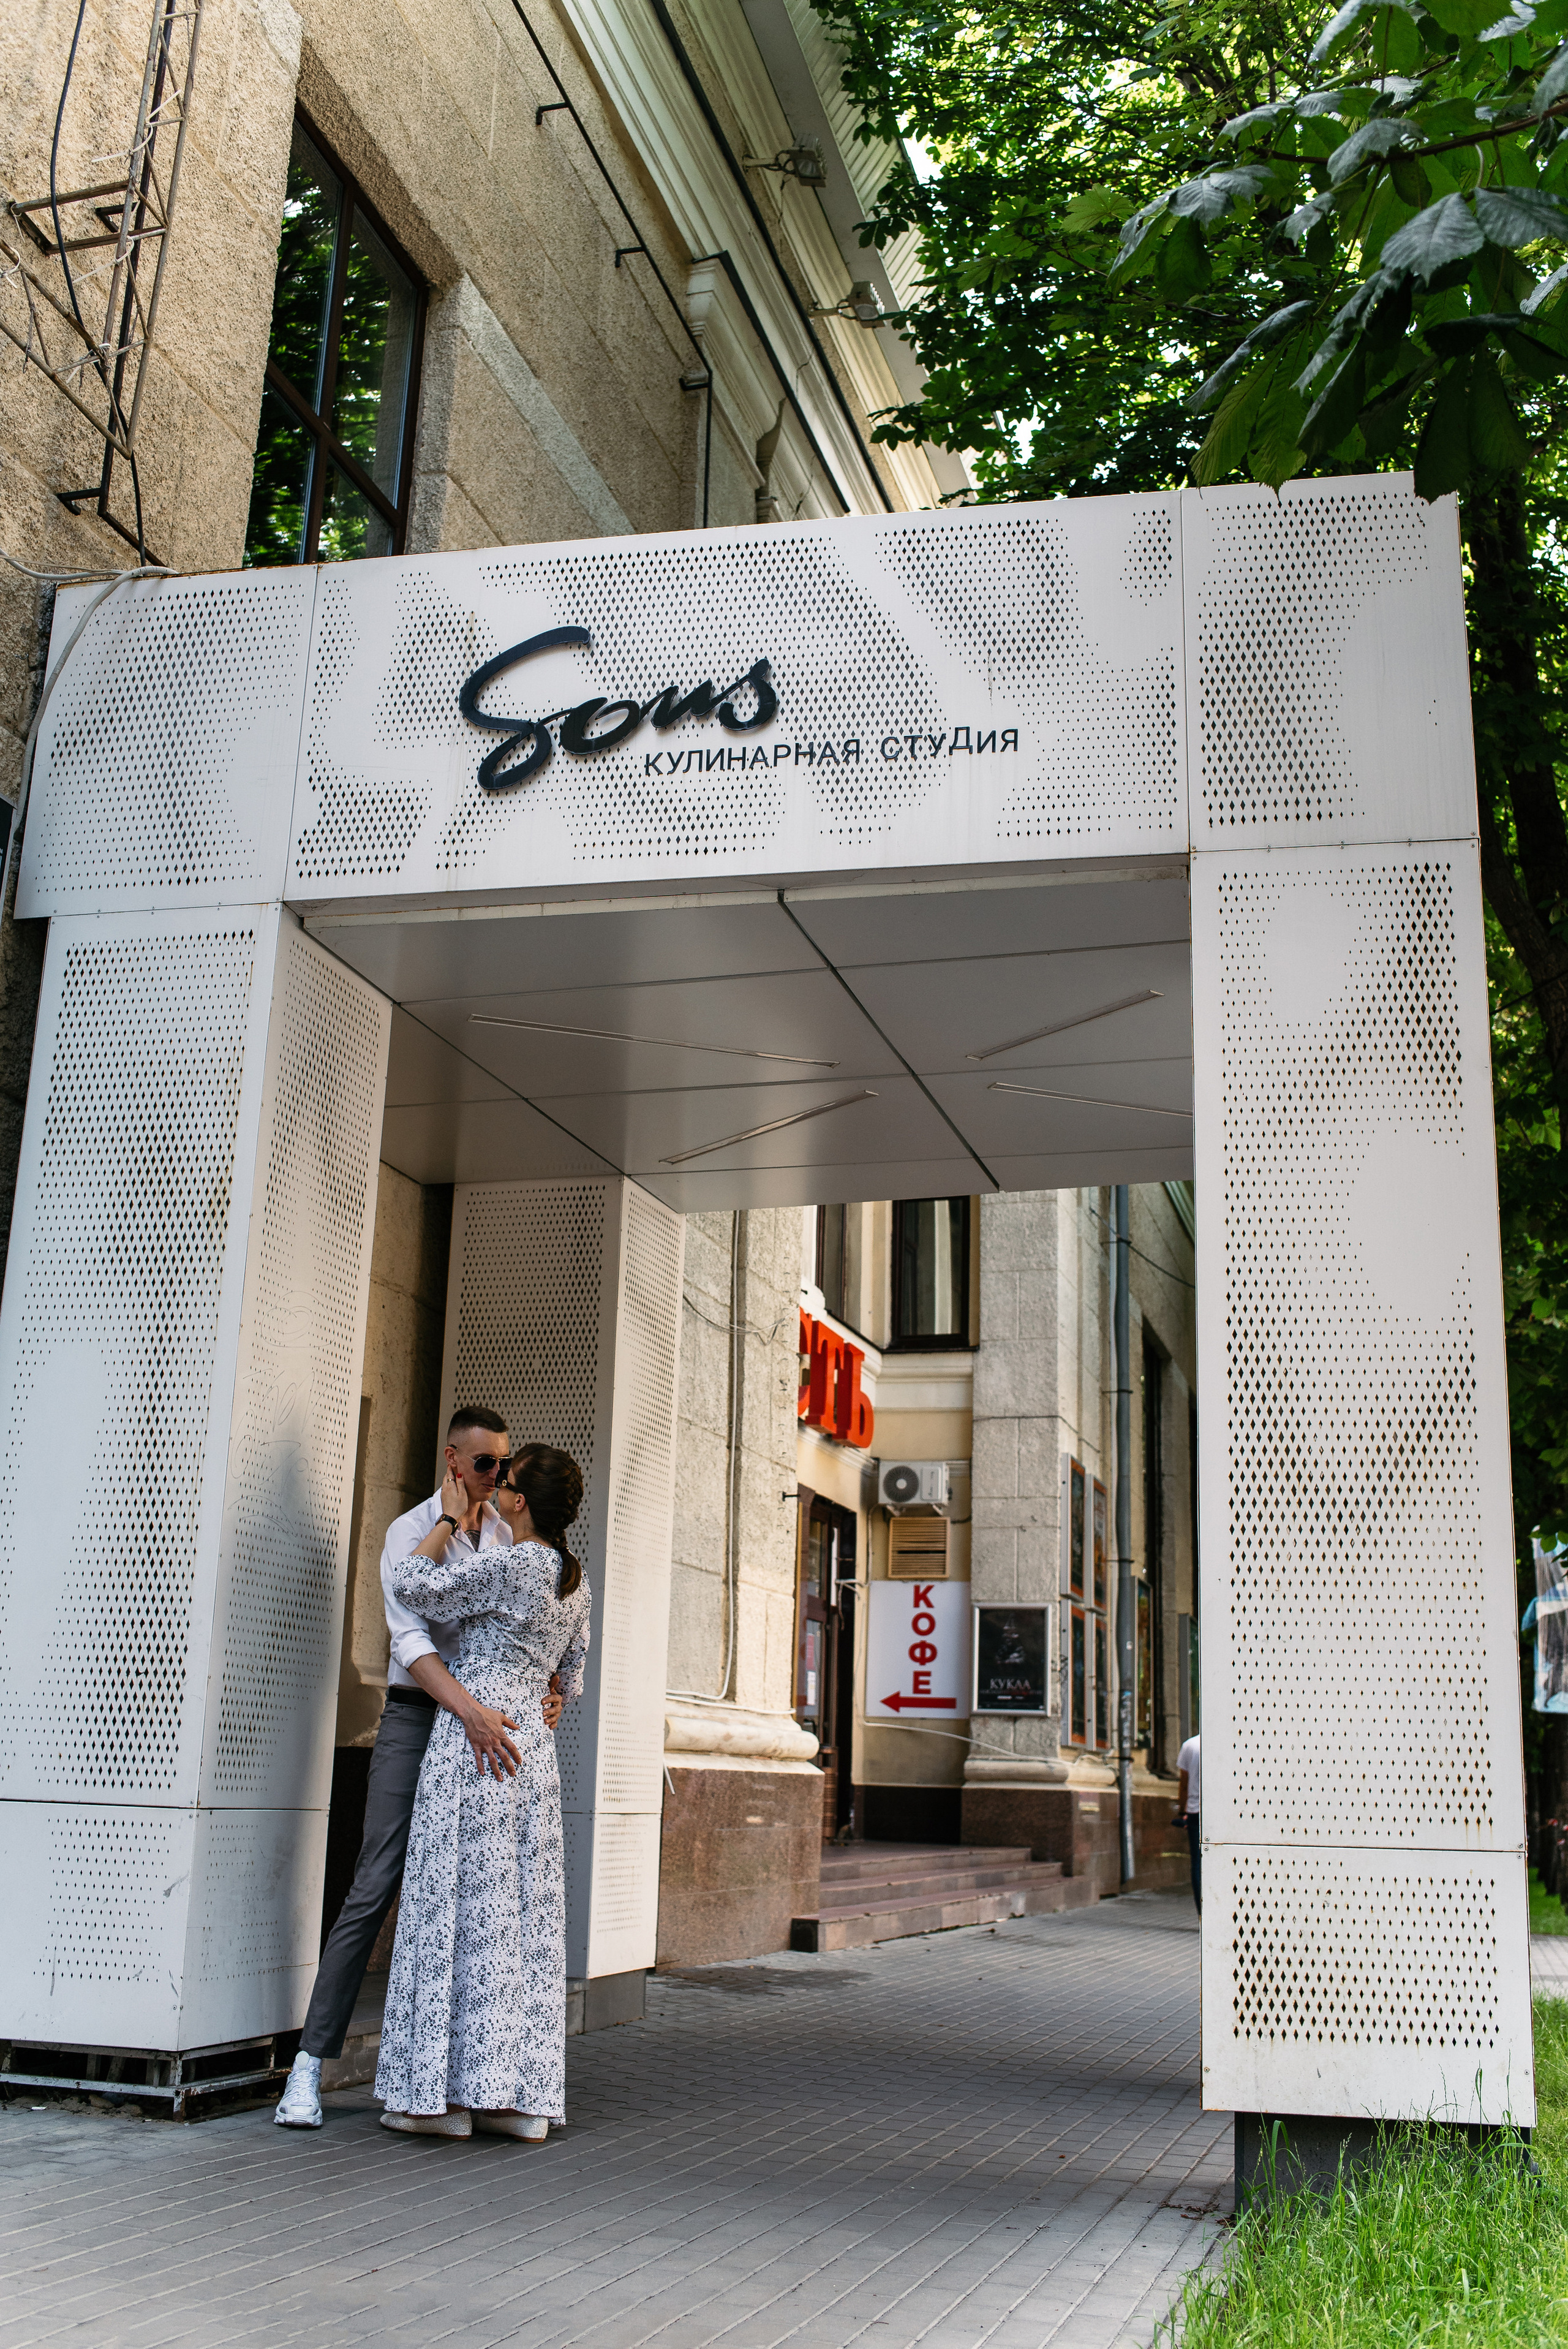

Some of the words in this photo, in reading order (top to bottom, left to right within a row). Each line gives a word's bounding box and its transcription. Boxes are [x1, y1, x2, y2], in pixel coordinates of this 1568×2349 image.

[644, 738, 861, 776] КУЛИНАРНАЯ
[880, 725, 1019, 760] СТУДИЯ
[908, 1584, 938, 1695] КОФЕ
